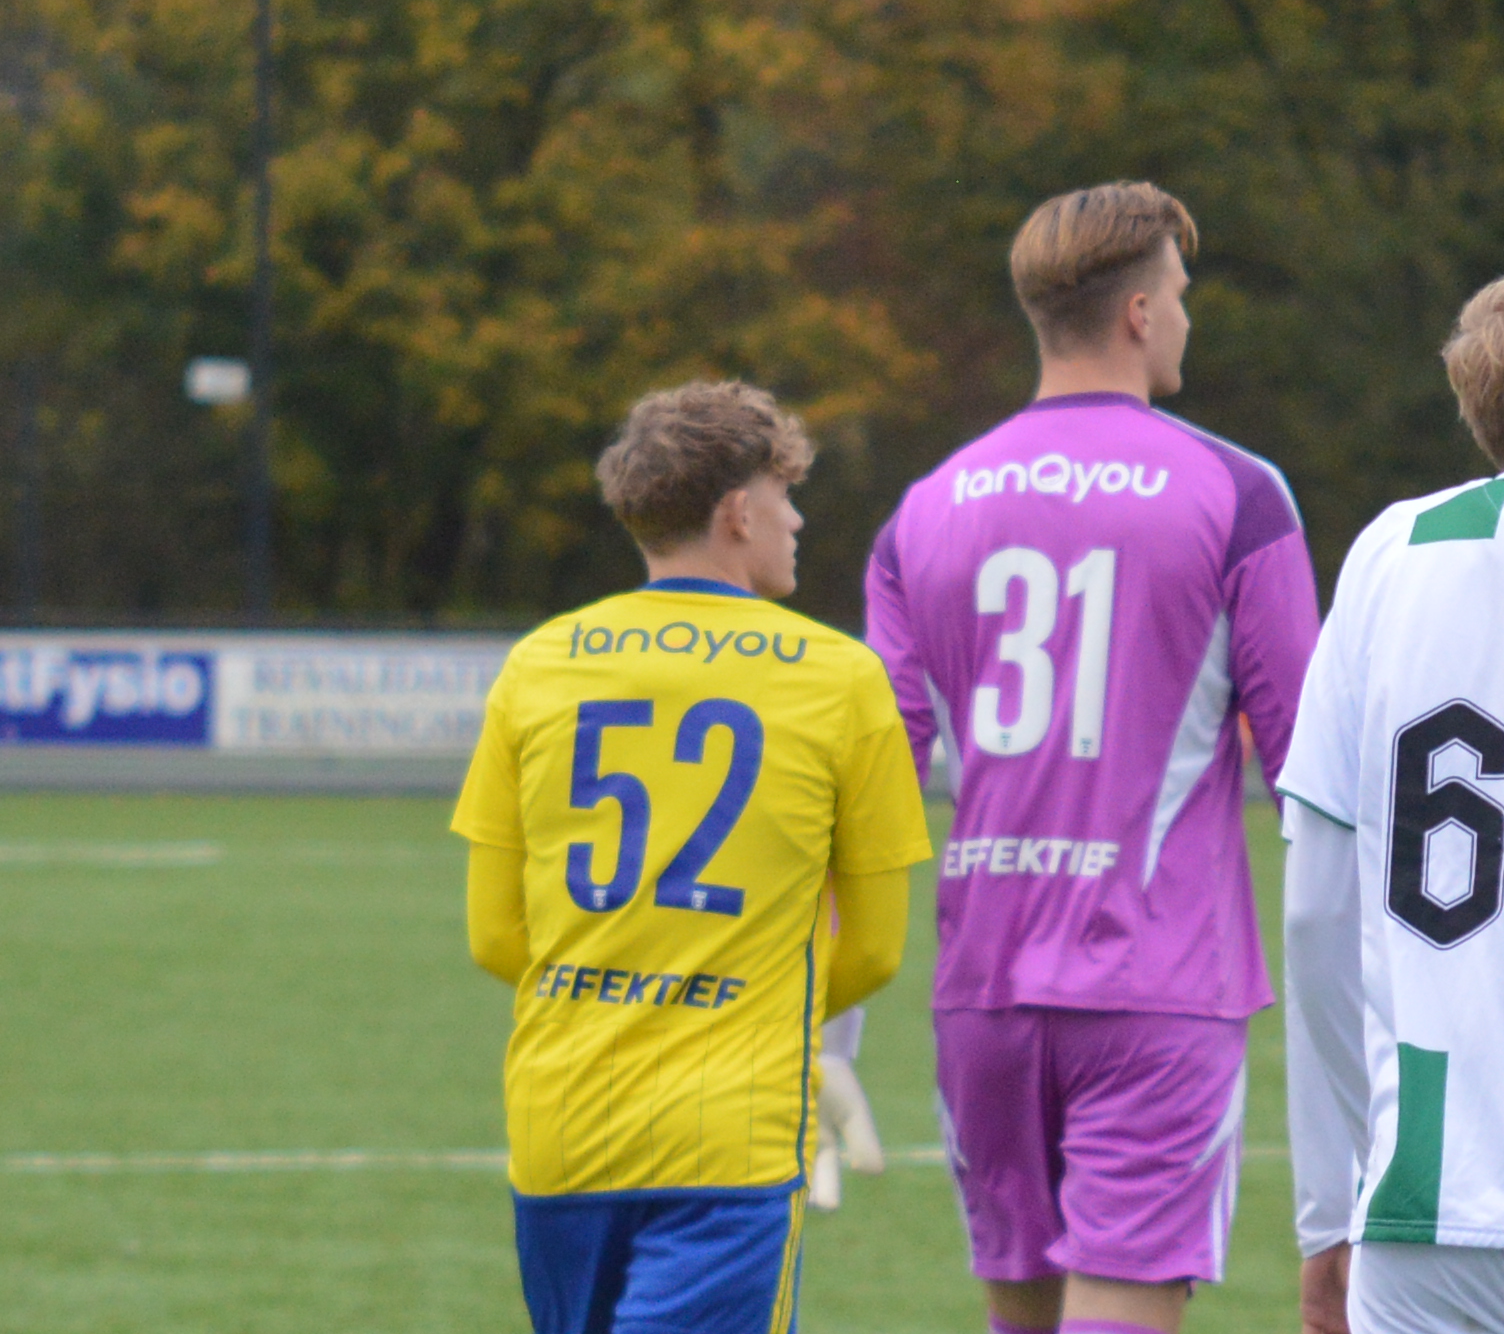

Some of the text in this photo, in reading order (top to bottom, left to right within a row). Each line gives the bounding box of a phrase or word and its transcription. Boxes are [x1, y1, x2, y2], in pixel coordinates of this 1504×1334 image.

[955, 453, 1169, 505] tanQyou
[569, 622, 808, 664] tanQyou
[972, 546, 1116, 759] 31
[565, 698, 765, 918] 52
[536, 963, 747, 1009] EFFEKTIEF
